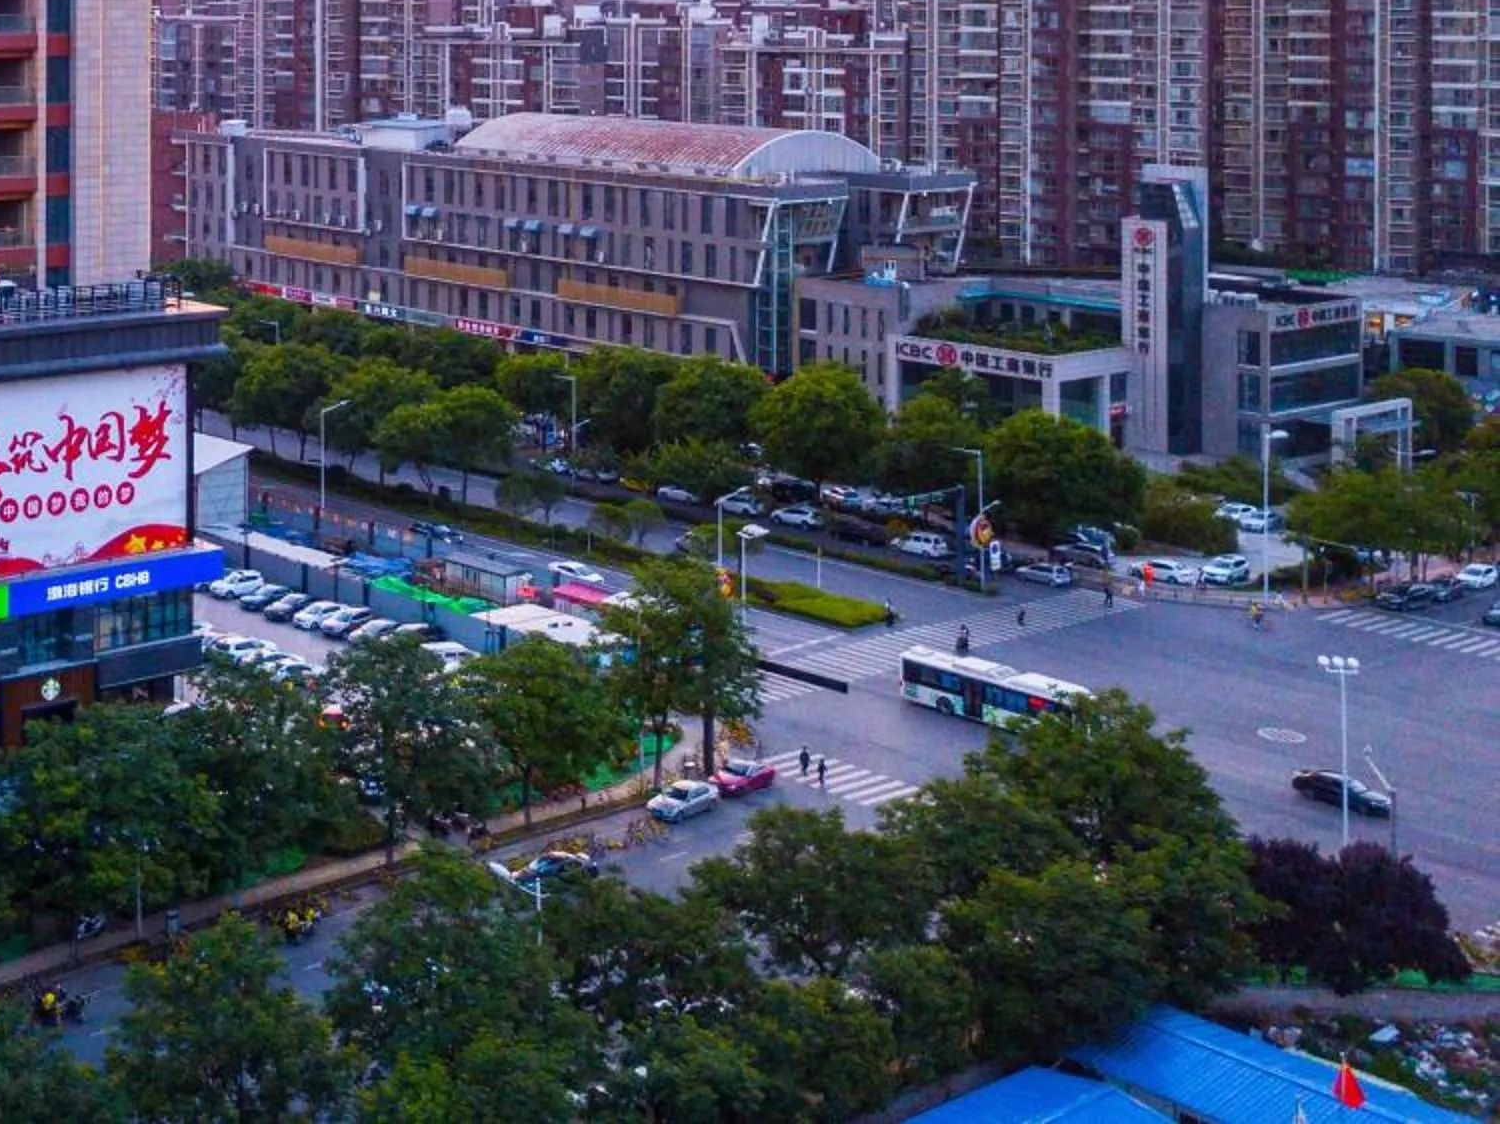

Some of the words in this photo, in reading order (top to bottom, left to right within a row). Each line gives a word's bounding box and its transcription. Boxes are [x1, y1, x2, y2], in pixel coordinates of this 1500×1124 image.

[895, 341, 933, 360] ICBC
[960, 350, 1053, 378] 中国工商银行
